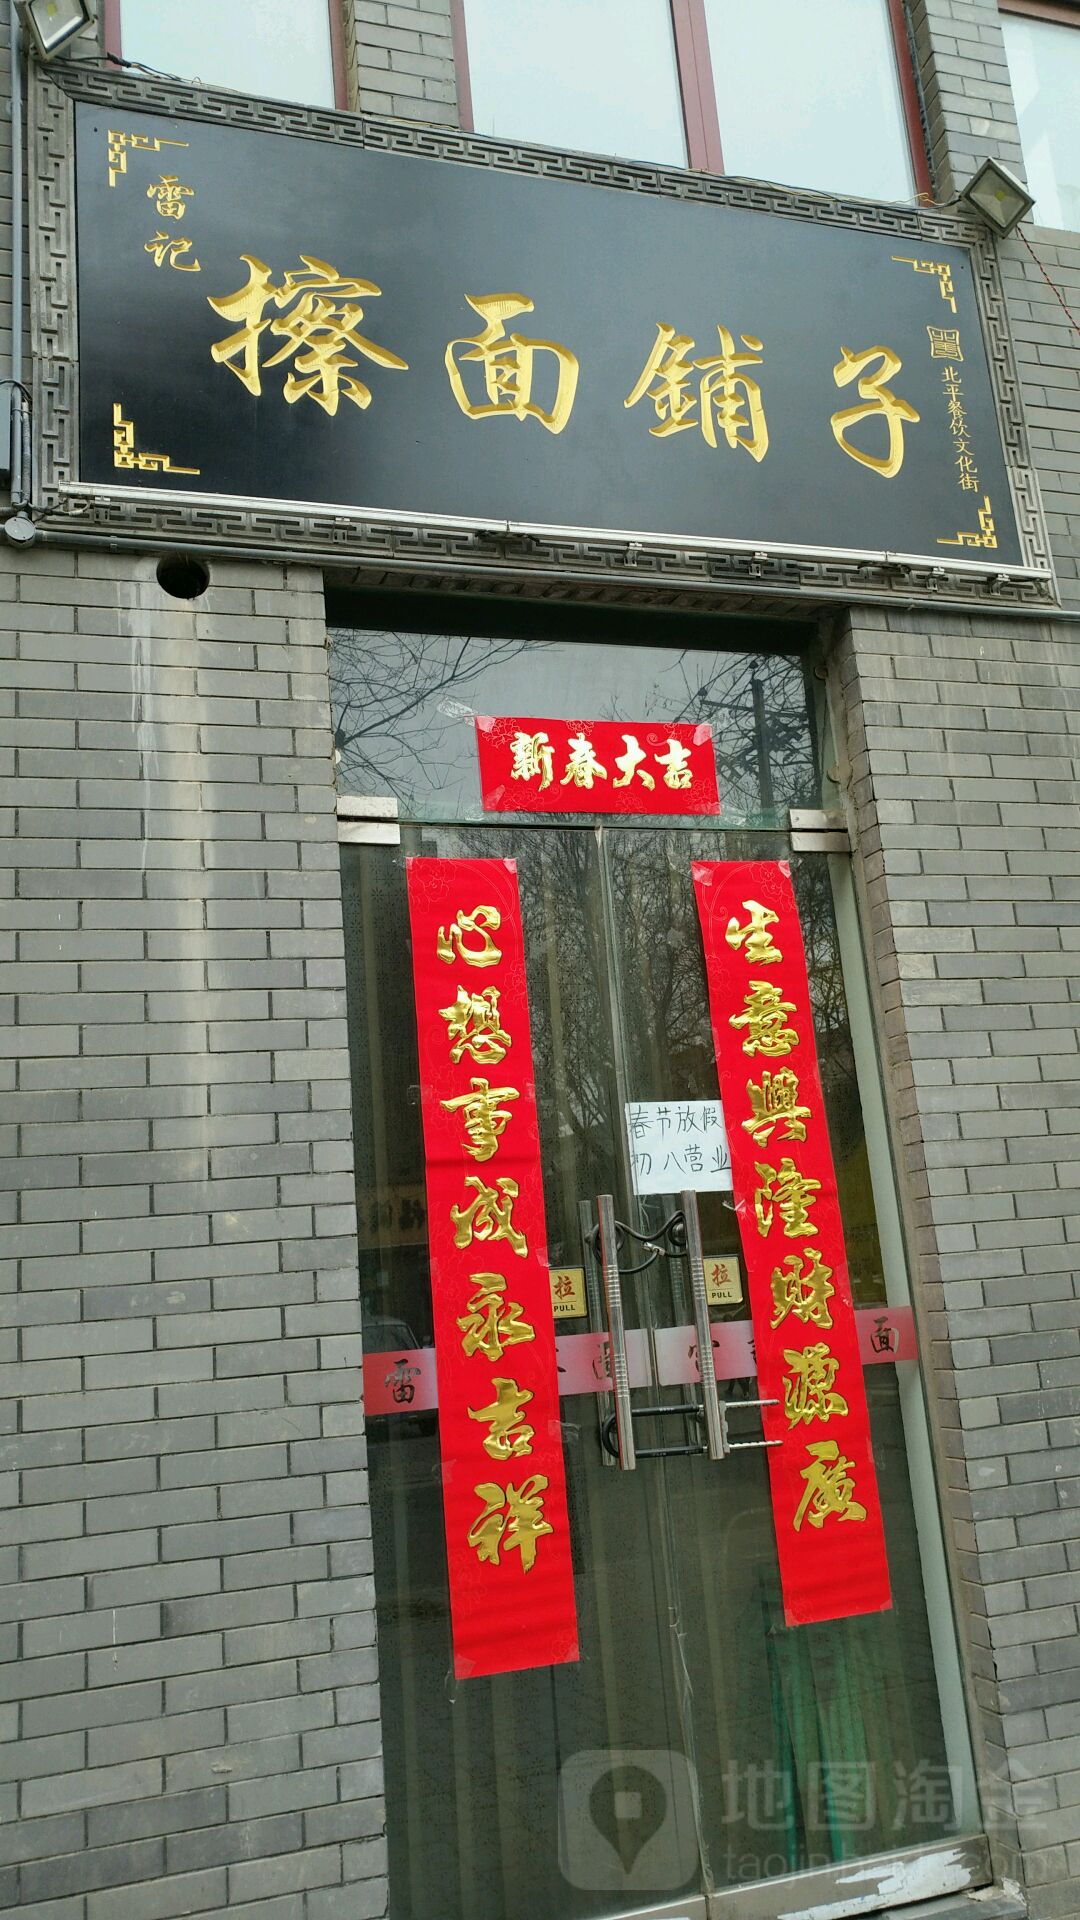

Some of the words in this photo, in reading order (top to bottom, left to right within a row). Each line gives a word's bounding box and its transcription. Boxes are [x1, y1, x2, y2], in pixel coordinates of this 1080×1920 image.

[143, 174, 201, 271] 雷记
[941, 365, 980, 493] 北平餐饮文化街
[510, 731, 693, 792] 新春大吉
[629, 1104, 723, 1141] 春节放假
[631, 1143, 732, 1176] 初八营业
[435, 904, 554, 1575] 心想事成永吉祥
[553, 1275, 576, 1299] 拉
[710, 1263, 732, 1287] 拉
[553, 1303, 576, 1312] PULL
[711, 1291, 733, 1299] PULL
[870, 1315, 899, 1354] 面
[384, 1358, 421, 1404] 雷
